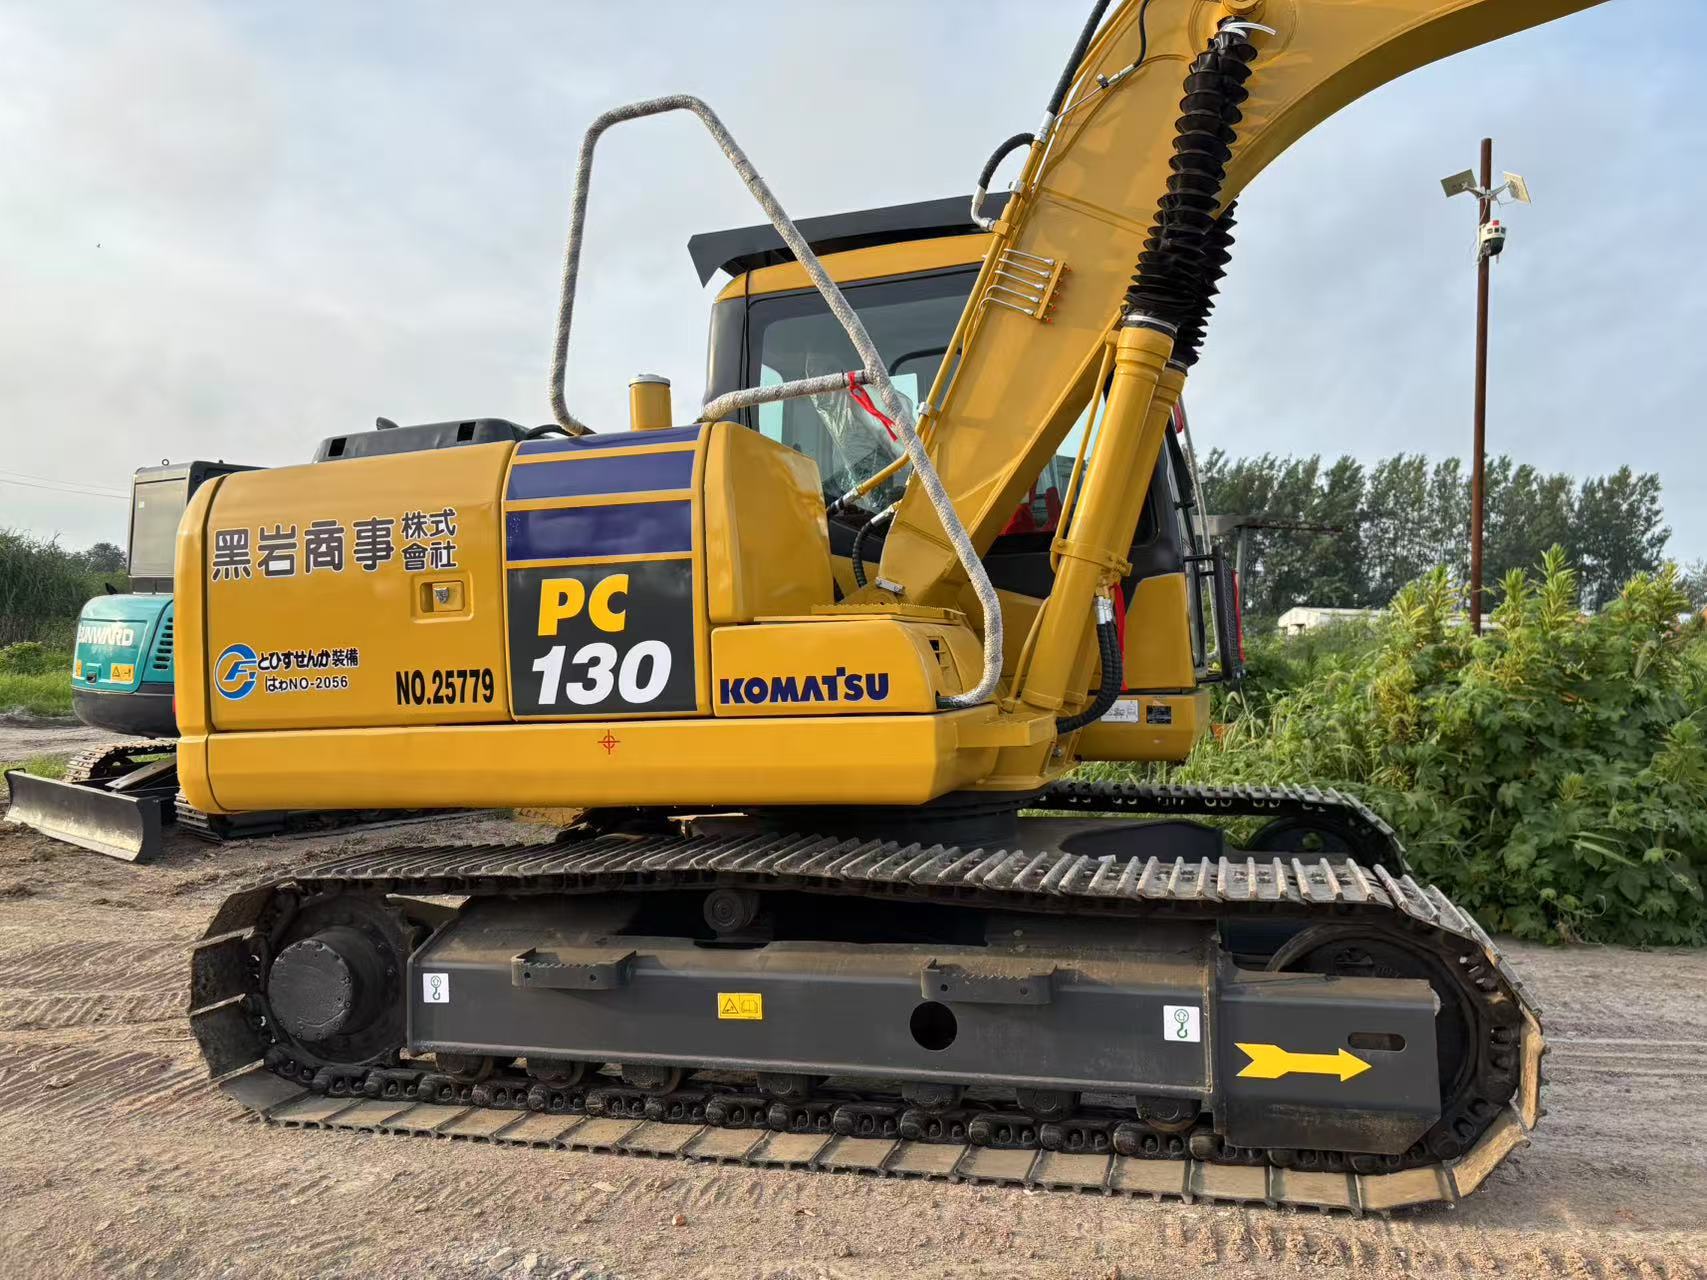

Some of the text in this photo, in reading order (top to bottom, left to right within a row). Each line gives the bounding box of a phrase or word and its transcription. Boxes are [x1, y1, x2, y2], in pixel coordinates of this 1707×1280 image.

[401, 508, 457, 540] 株式
[401, 540, 458, 571] 會社
[537, 573, 630, 637] PC
[396, 667, 494, 705] NO.25779
[532, 640, 673, 705] 130
[719, 666, 890, 704] KOMATSU
